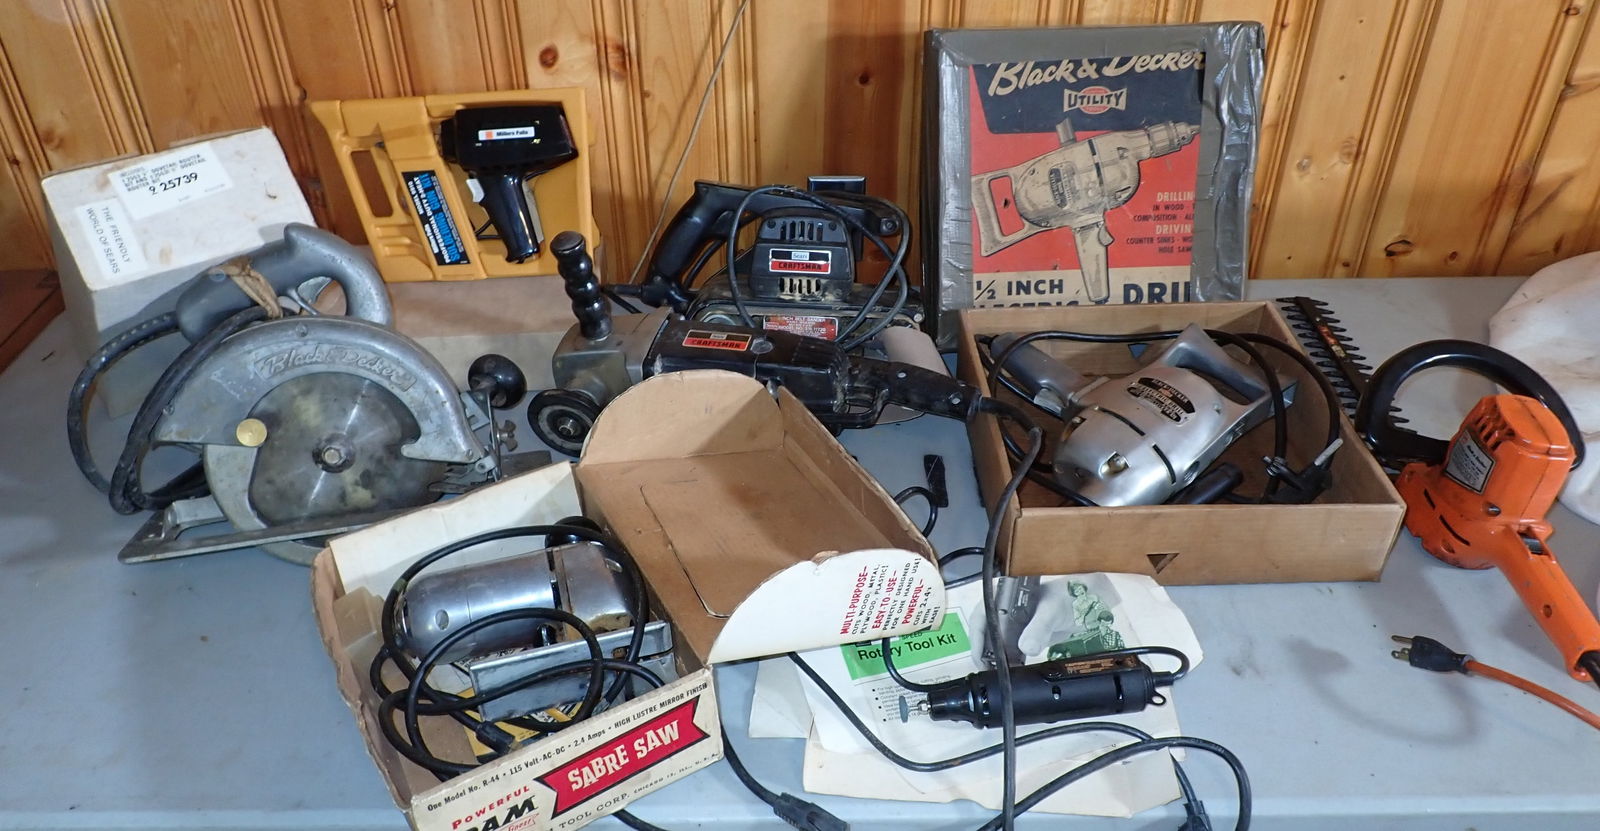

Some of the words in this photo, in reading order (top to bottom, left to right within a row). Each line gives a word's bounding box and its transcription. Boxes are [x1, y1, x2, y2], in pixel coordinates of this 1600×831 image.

[988, 60, 1077, 96] Black
[1077, 58, 1099, 80] &
[1067, 90, 1124, 108] UTILITY
[160, 172, 198, 192] 25739
[418, 173, 433, 189] KIT
[422, 198, 432, 216] DUTY
[426, 190, 440, 210] GUN
[1157, 192, 1195, 202] DRILLIN
[102, 206, 114, 222] THE
[110, 224, 130, 262] FRIENDLY
[434, 212, 460, 262] SOLDERING
[1156, 224, 1192, 234] DRIVIN
[86, 208, 104, 234] WORLD
[99, 236, 109, 245] OF
[104, 248, 120, 274] SEARS
[429, 215, 451, 264] PROFESSIONAL
[779, 262, 822, 270] CRAFTSMAN
[1007, 279, 1064, 296] INCH
[692, 340, 741, 348] CRAFTSMAN
[265, 343, 320, 375] Black
[882, 600, 898, 631] PERFECTLY
[896, 562, 911, 596] DESIGNED
[890, 617, 899, 629] FOR
[897, 600, 906, 614] ONE
[903, 576, 914, 597] HAND
[912, 558, 921, 574] USE!
[913, 610, 923, 626] CUTS
[921, 608, 931, 624] WITH
[929, 606, 940, 623] EASE!
[852, 620, 861, 634] CUTS
[858, 645, 902, 660] Rotry
[905, 639, 934, 652] Tool
[936, 633, 957, 646] Kit
[428, 802, 442, 812] One
[444, 790, 466, 804] Model
[468, 784, 481, 794] No.
[482, 774, 500, 787] R-44
[509, 766, 522, 776] 115
[574, 736, 586, 747] 2.4
[588, 729, 606, 743] Amps
[614, 717, 631, 729] HIGH
[633, 705, 657, 720] LUSTRE
[659, 694, 685, 708] MIRROR
[686, 682, 708, 697] FINISH
[568, 744, 630, 791] SABRE
[633, 720, 679, 760] SAW
[452, 785, 530, 830] POWERFUL
[559, 811, 592, 828] TOOL
[596, 792, 630, 812] CORP.
[634, 778, 664, 793] CHICAGO
